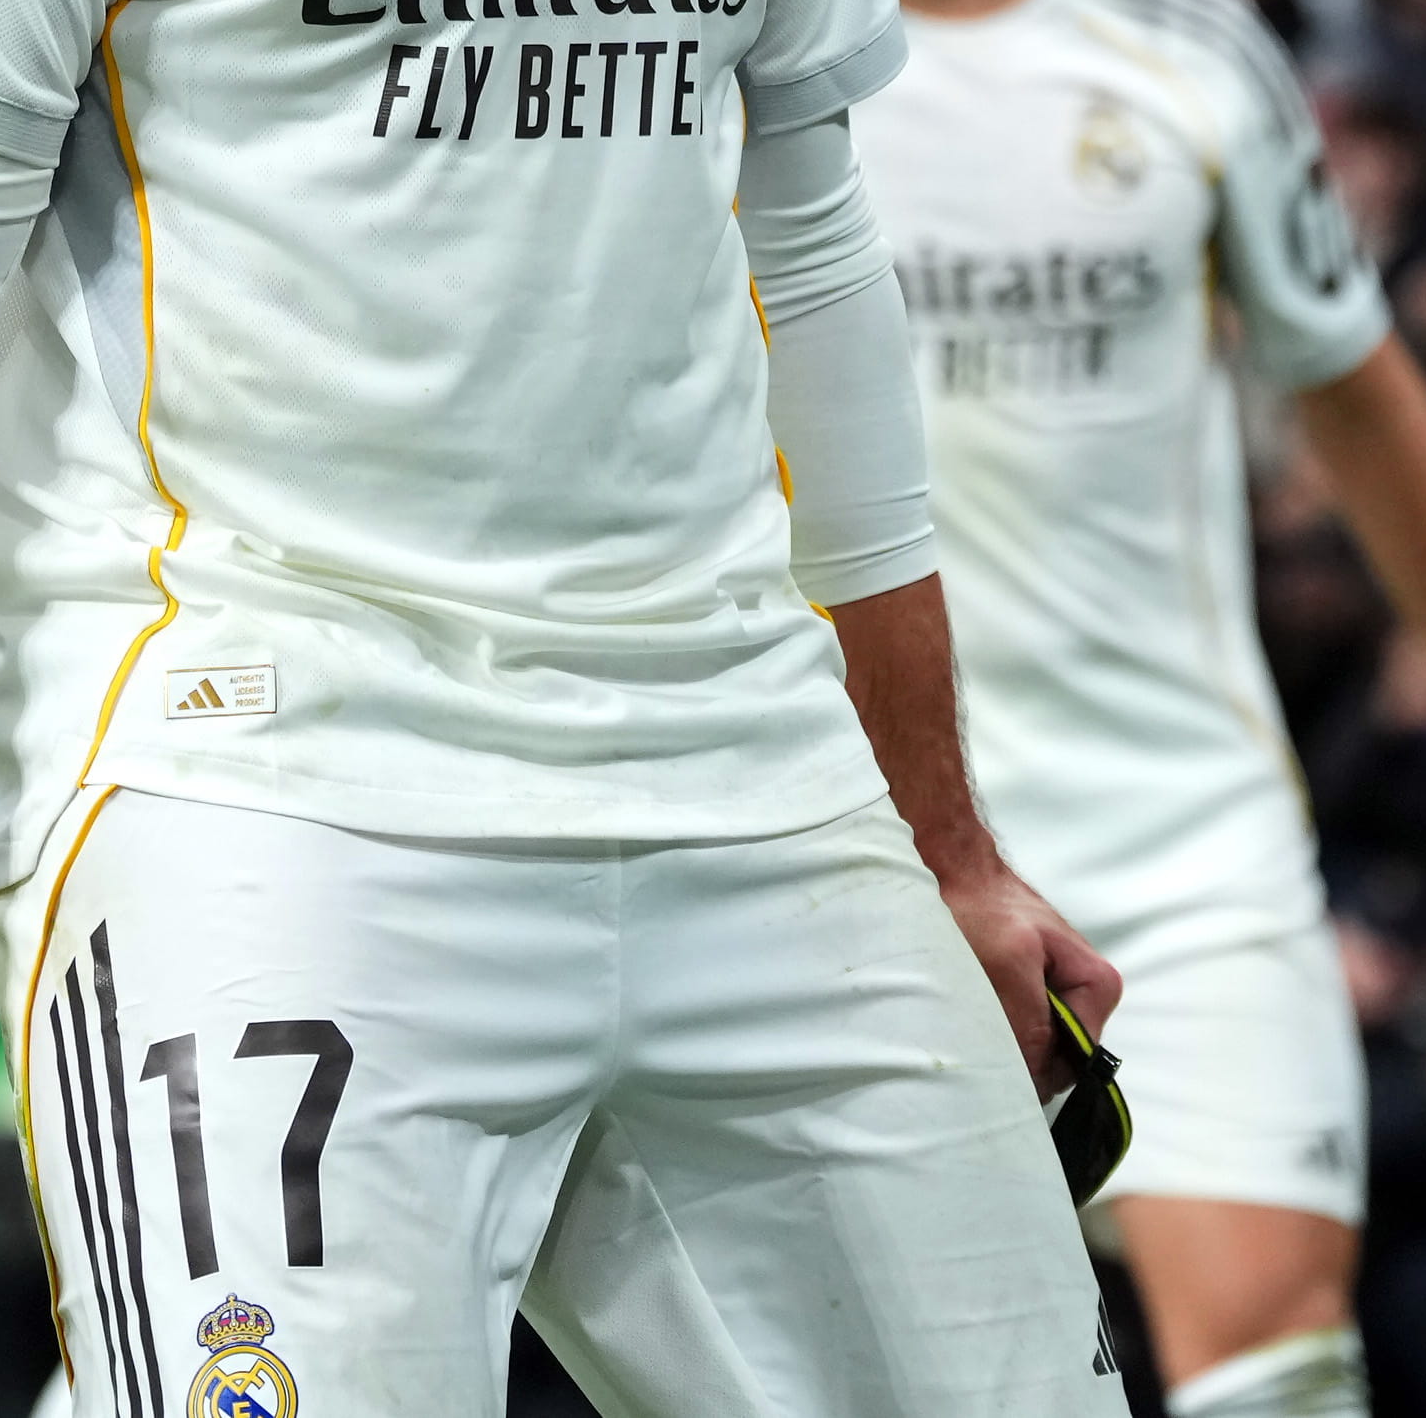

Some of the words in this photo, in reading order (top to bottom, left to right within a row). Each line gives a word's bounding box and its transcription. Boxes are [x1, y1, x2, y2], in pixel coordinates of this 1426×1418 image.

[372, 43, 495, 141] FLY
[514, 40, 703, 139] BETTE
[229, 673, 265, 684] AUTHENTIC
[234, 685, 265, 695] LICENSED
[235, 697, 265, 708] PRODUCT
[139, 1019, 354, 1281] 17
